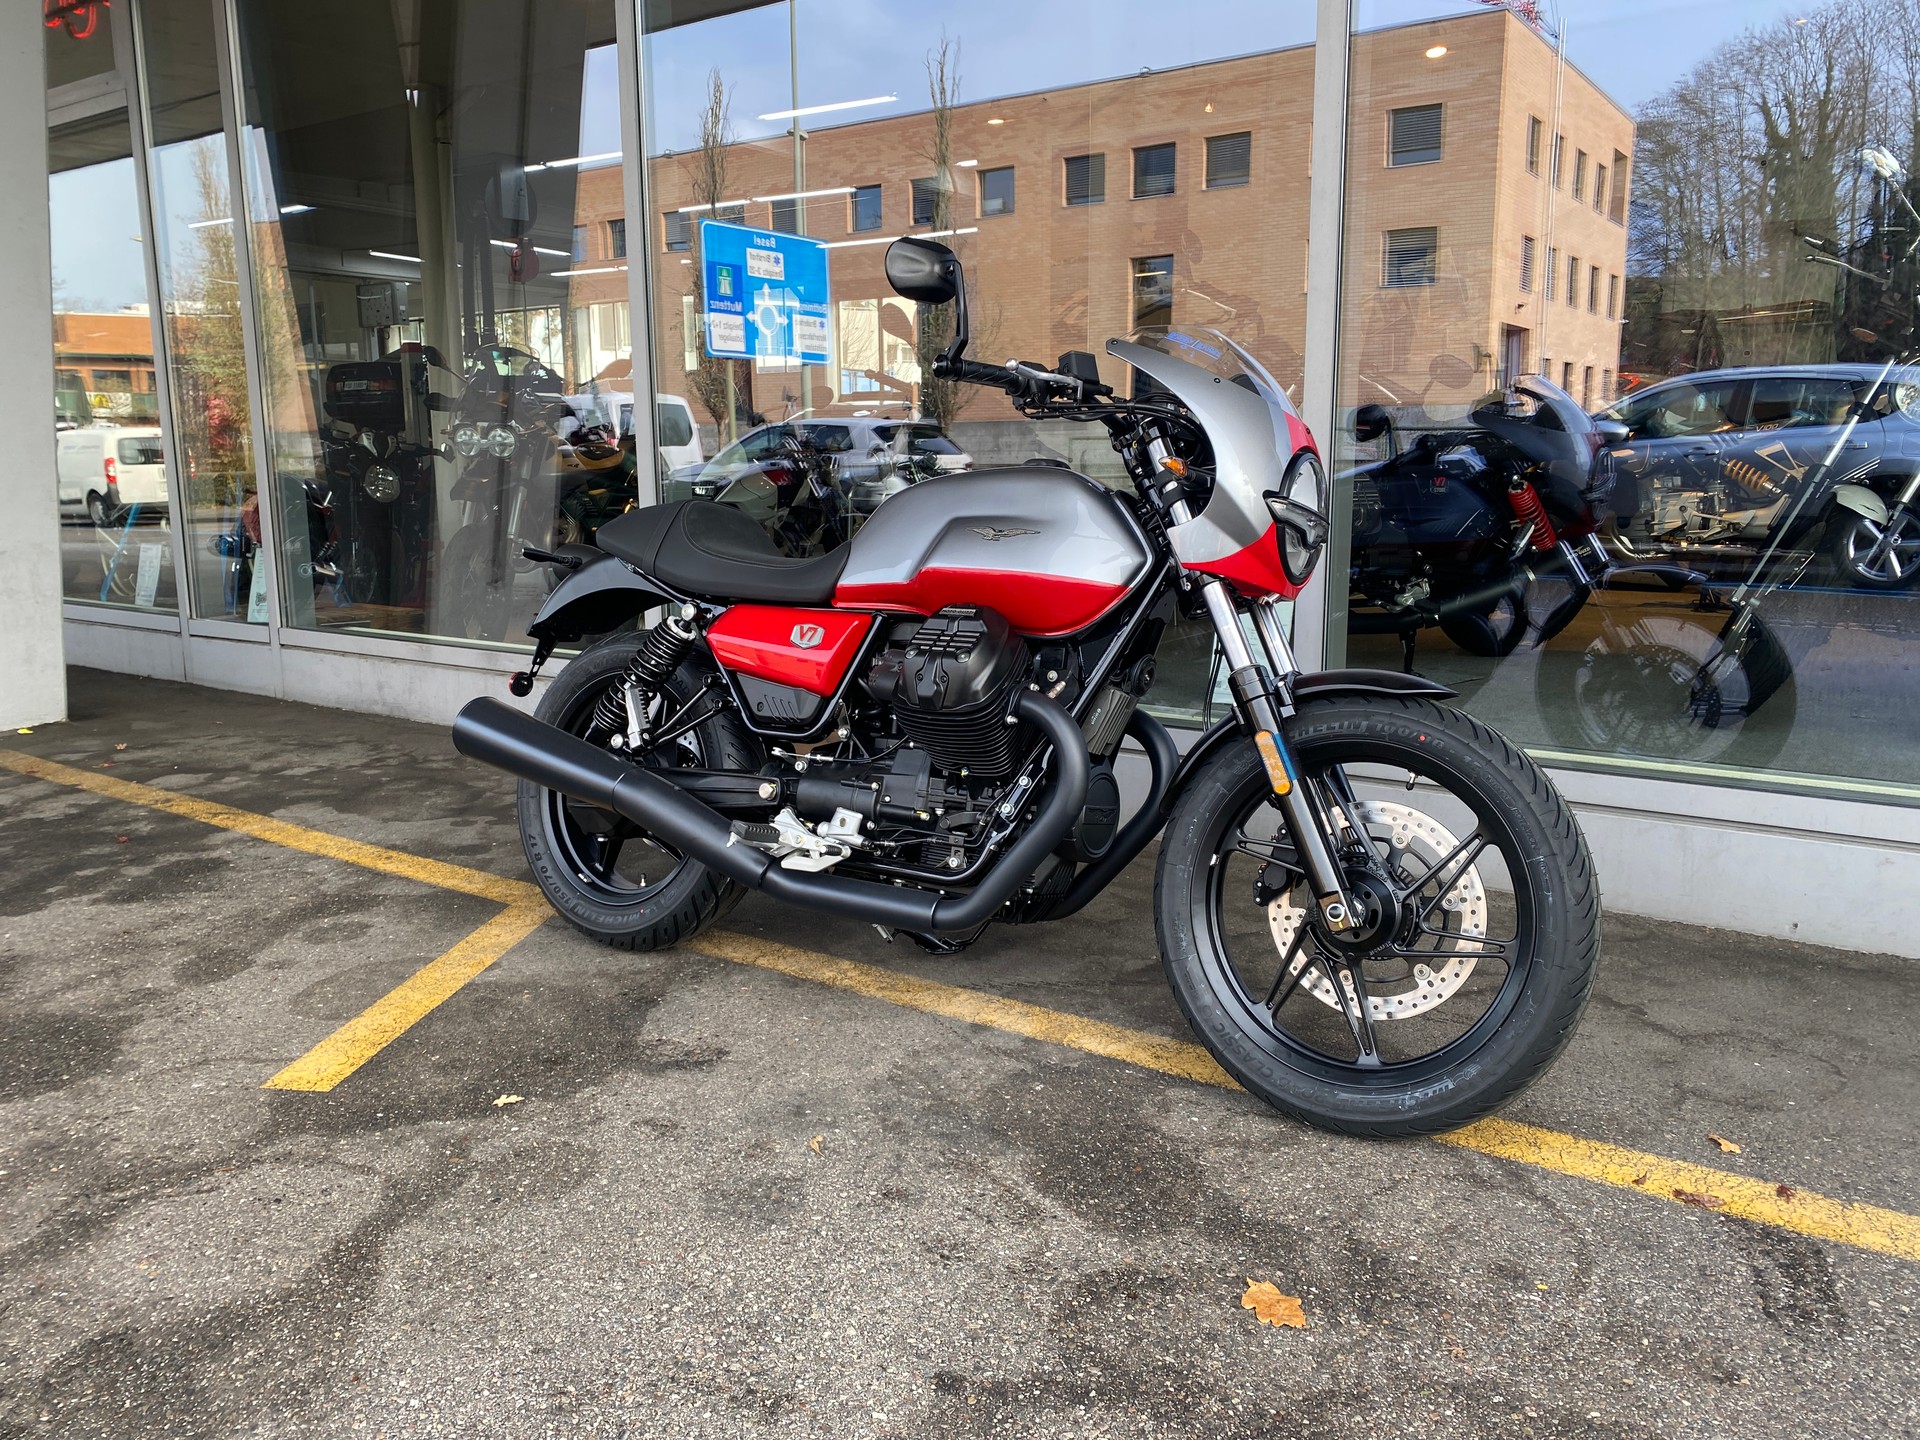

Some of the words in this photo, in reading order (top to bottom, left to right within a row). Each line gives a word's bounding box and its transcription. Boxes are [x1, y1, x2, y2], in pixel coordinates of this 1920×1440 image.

[1433, 477, 1446, 486] V7
[800, 625, 818, 642] V7
[527, 830, 538, 849] 17
[538, 863, 571, 906] 150/70
[573, 902, 641, 925] MICHELIN
[1210, 1018, 1276, 1081] CLASSIC
